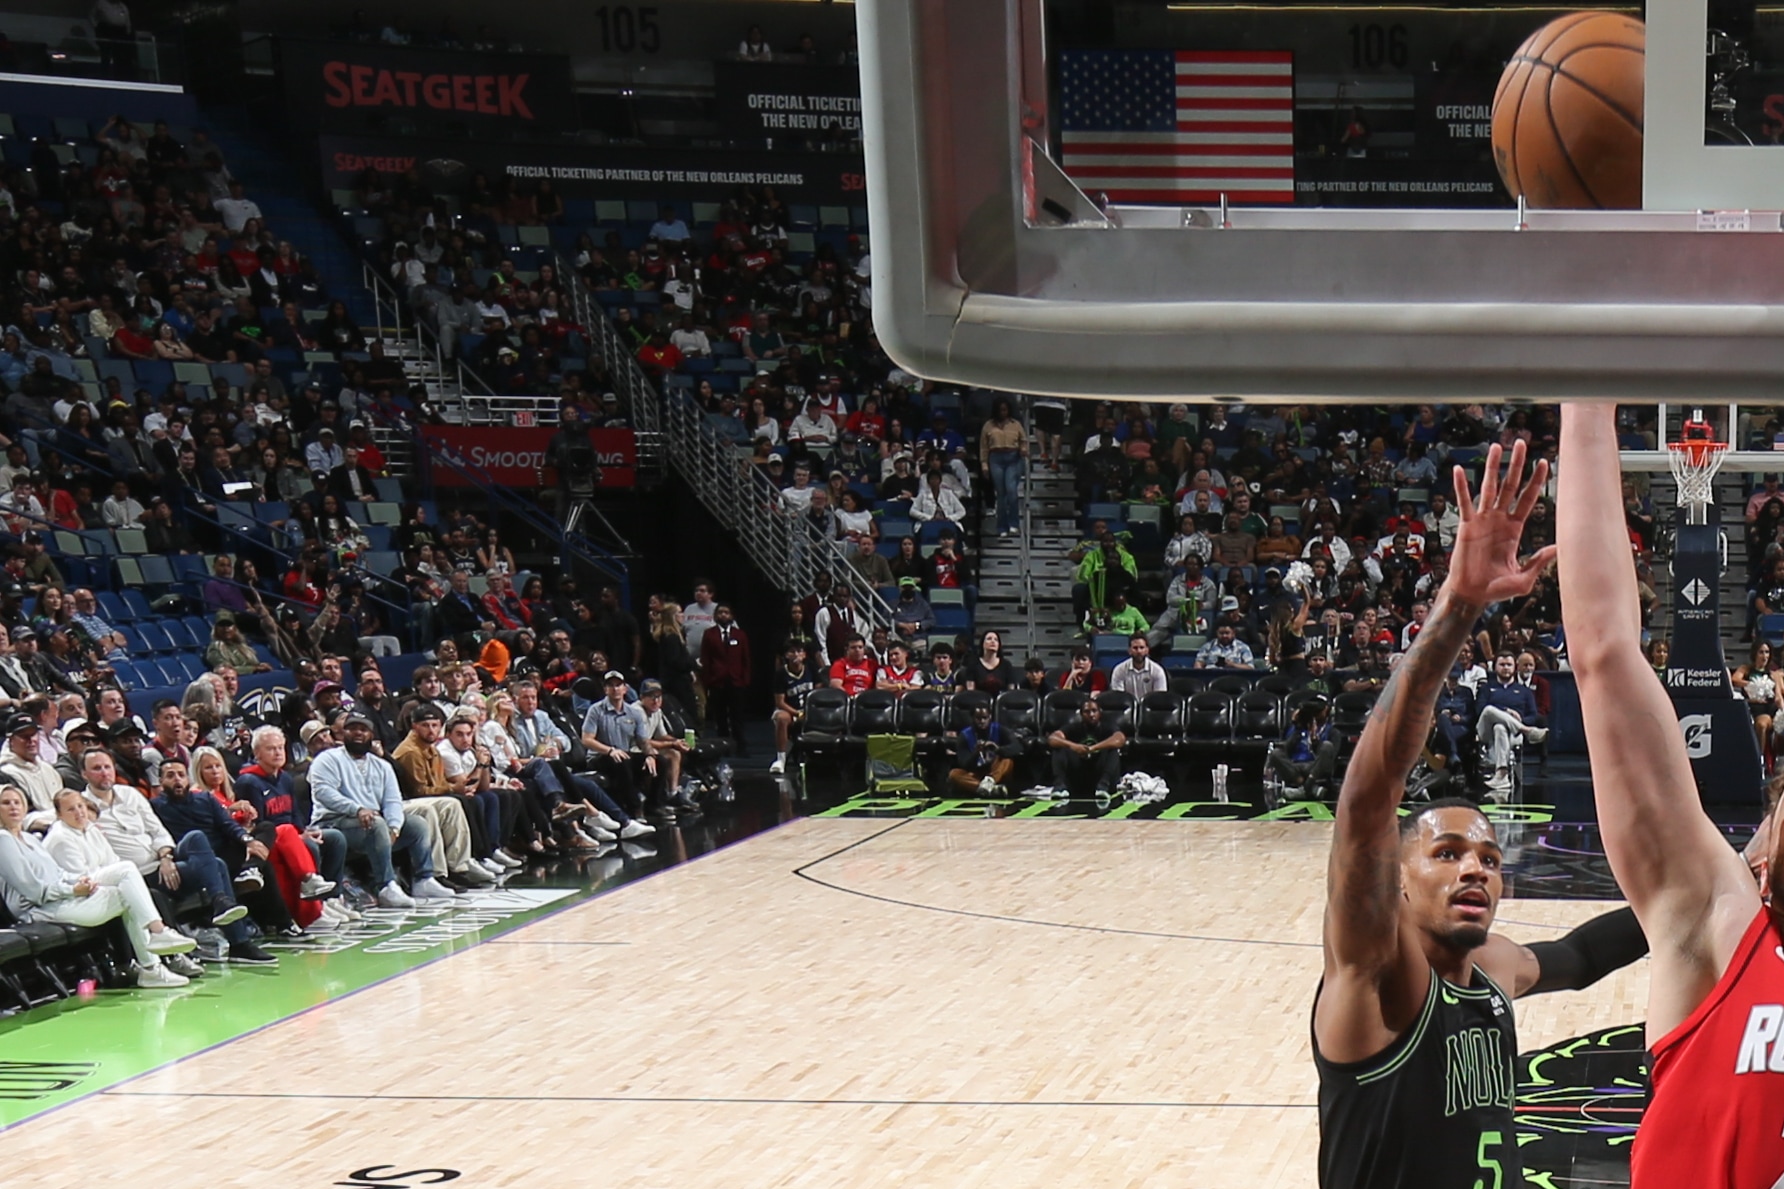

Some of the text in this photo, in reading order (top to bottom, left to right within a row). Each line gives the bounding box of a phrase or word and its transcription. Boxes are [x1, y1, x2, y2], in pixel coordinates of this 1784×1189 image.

[595, 6, 660, 53] 105
[1348, 23, 1409, 70] 106
[323, 60, 535, 120] SEATGEEK
[748, 94, 806, 111] OFFICIAL
[1436, 105, 1492, 119] OFFICIAL
[761, 113, 787, 128] THE
[788, 114, 818, 129] NEW
[1448, 124, 1472, 138] THE
[551, 167, 603, 179] TICKETING
[604, 168, 650, 181] PARTNER
[651, 170, 665, 181] OF
[666, 170, 685, 182] THE
[686, 170, 709, 183] NEW
[710, 171, 755, 184] ORLEANS
[756, 172, 803, 185] PELICANS
[1317, 181, 1357, 192] PARTNER
[1358, 181, 1371, 192] OF
[1371, 181, 1388, 192] THE
[1389, 182, 1409, 192] NEW
[1409, 182, 1450, 192] ORLEANS
[1451, 182, 1494, 193] PELICANS
[1687, 668, 1721, 678] Keesler
[1687, 678, 1721, 687] Federal
[808, 798, 1556, 824] PELICAS
[1445, 1028, 1514, 1116] NOL
